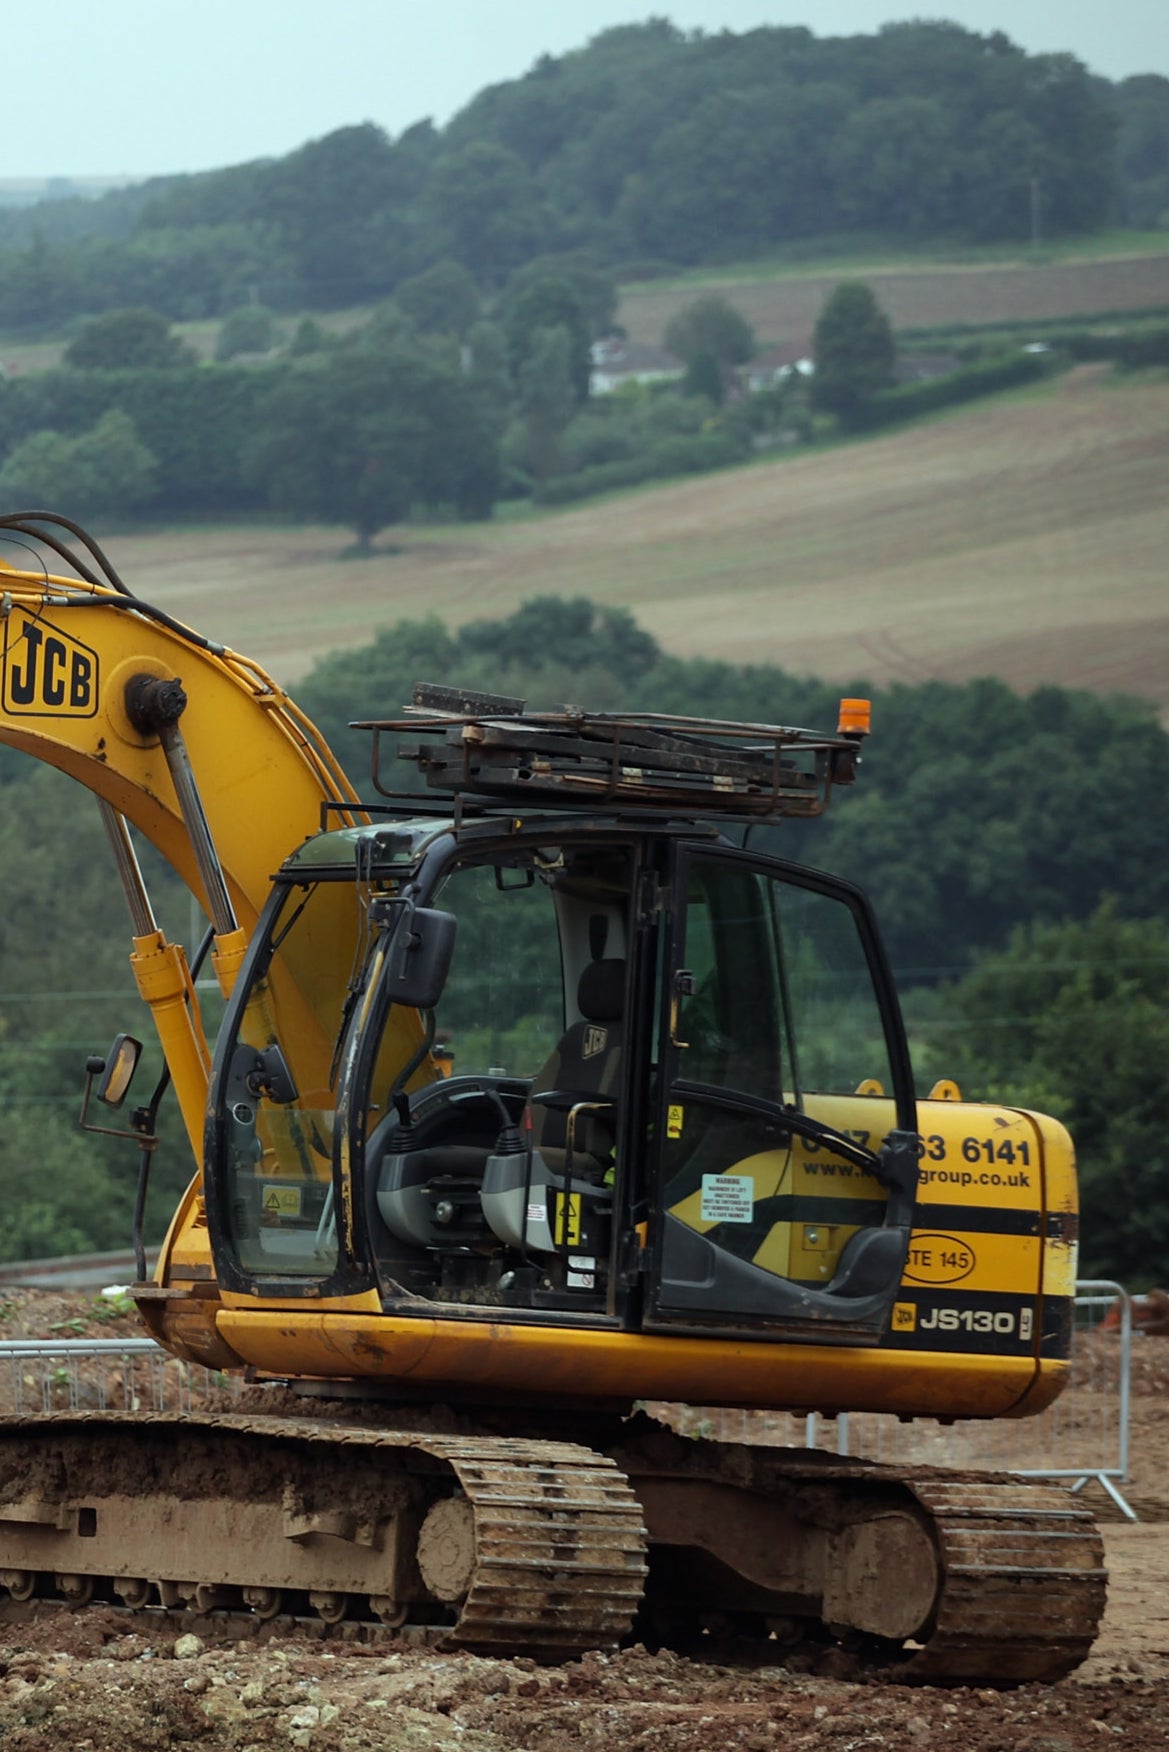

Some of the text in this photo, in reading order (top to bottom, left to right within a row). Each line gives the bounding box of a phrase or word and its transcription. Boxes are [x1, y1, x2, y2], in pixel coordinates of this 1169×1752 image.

[10, 619, 91, 708] JCB
[584, 1027, 607, 1056] JCB
[962, 1137, 1030, 1166] 6141
[940, 1252, 969, 1269] 145
[919, 1308, 1015, 1334] JS130
